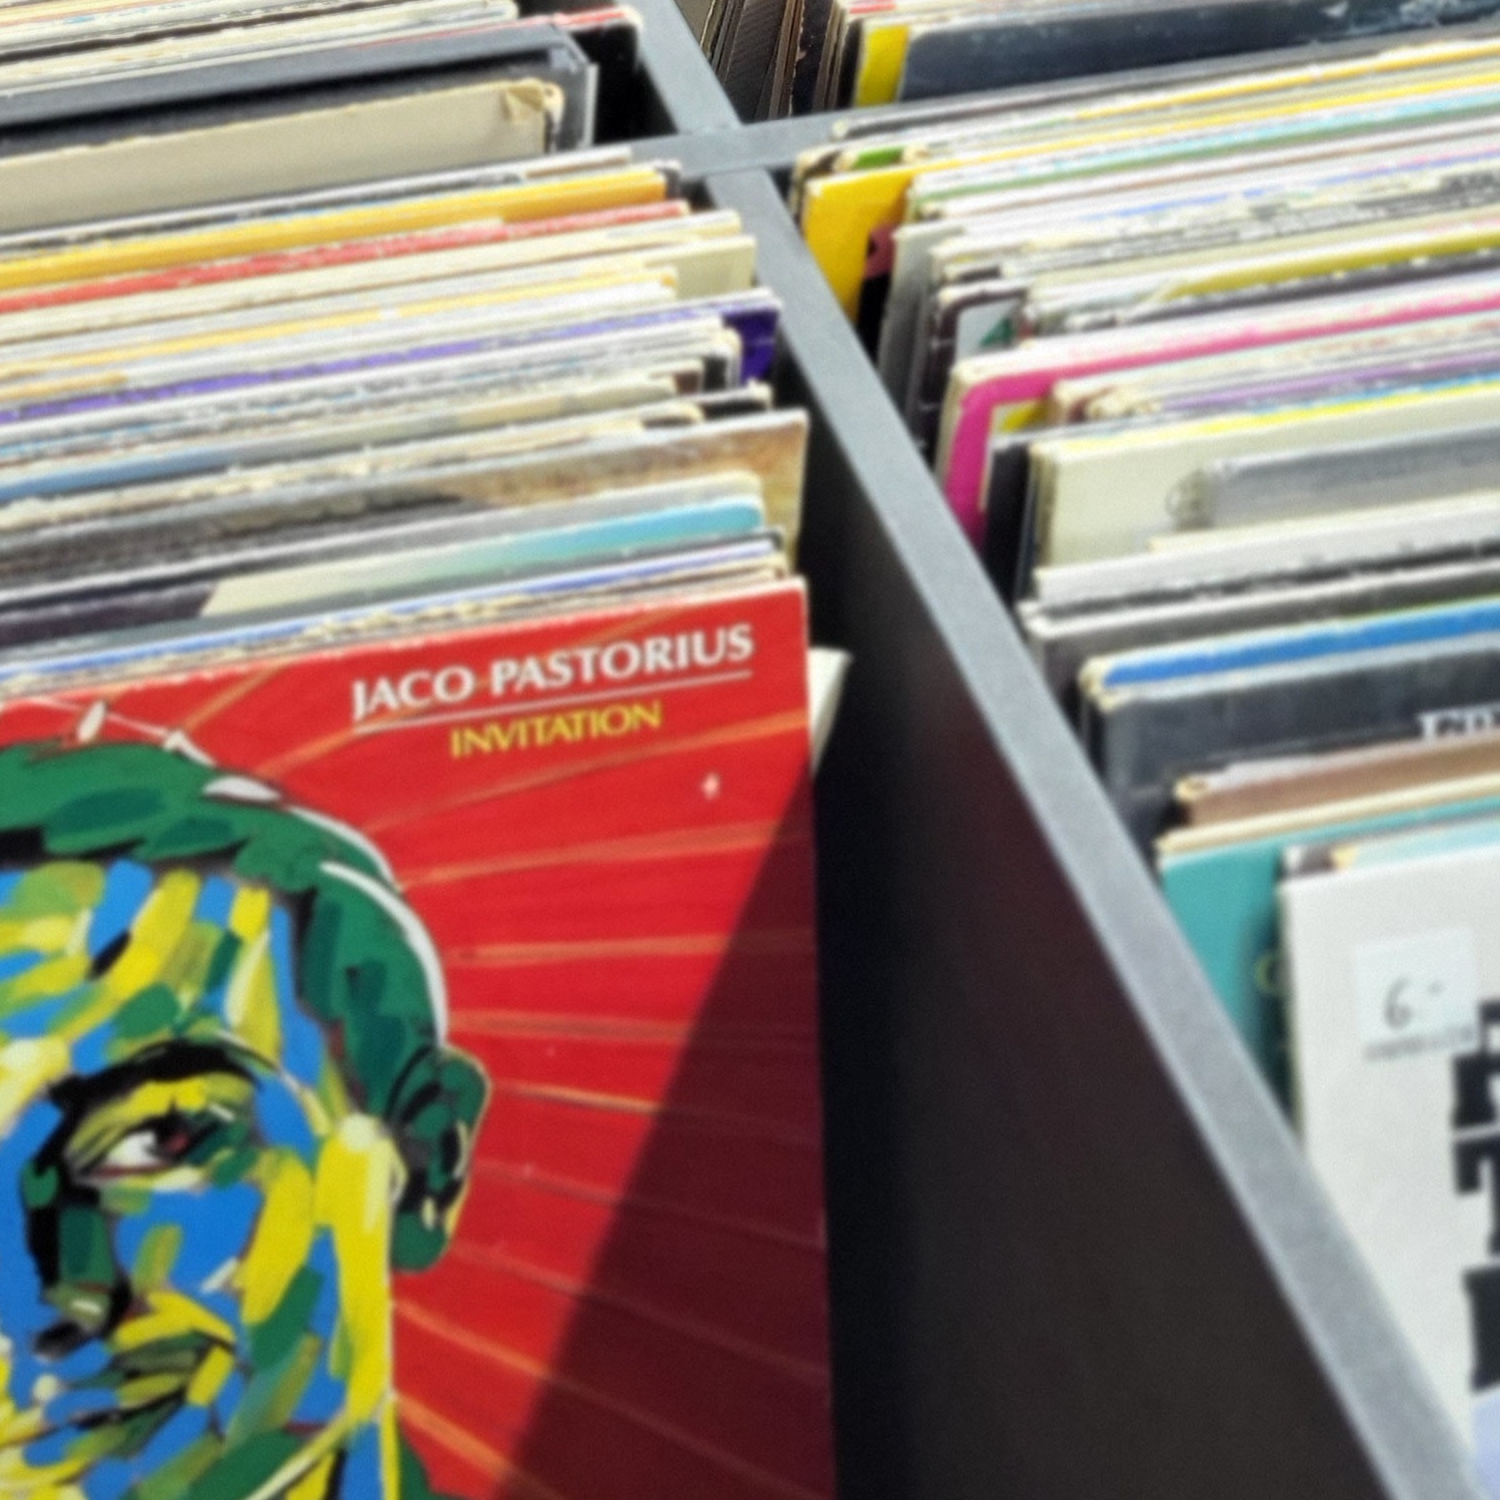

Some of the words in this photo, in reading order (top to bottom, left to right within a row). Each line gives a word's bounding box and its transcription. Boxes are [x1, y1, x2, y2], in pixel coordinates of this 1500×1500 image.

[352, 664, 474, 722] JACO
[490, 623, 753, 696] PASTORIUS
[451, 700, 662, 758] INVITATION
